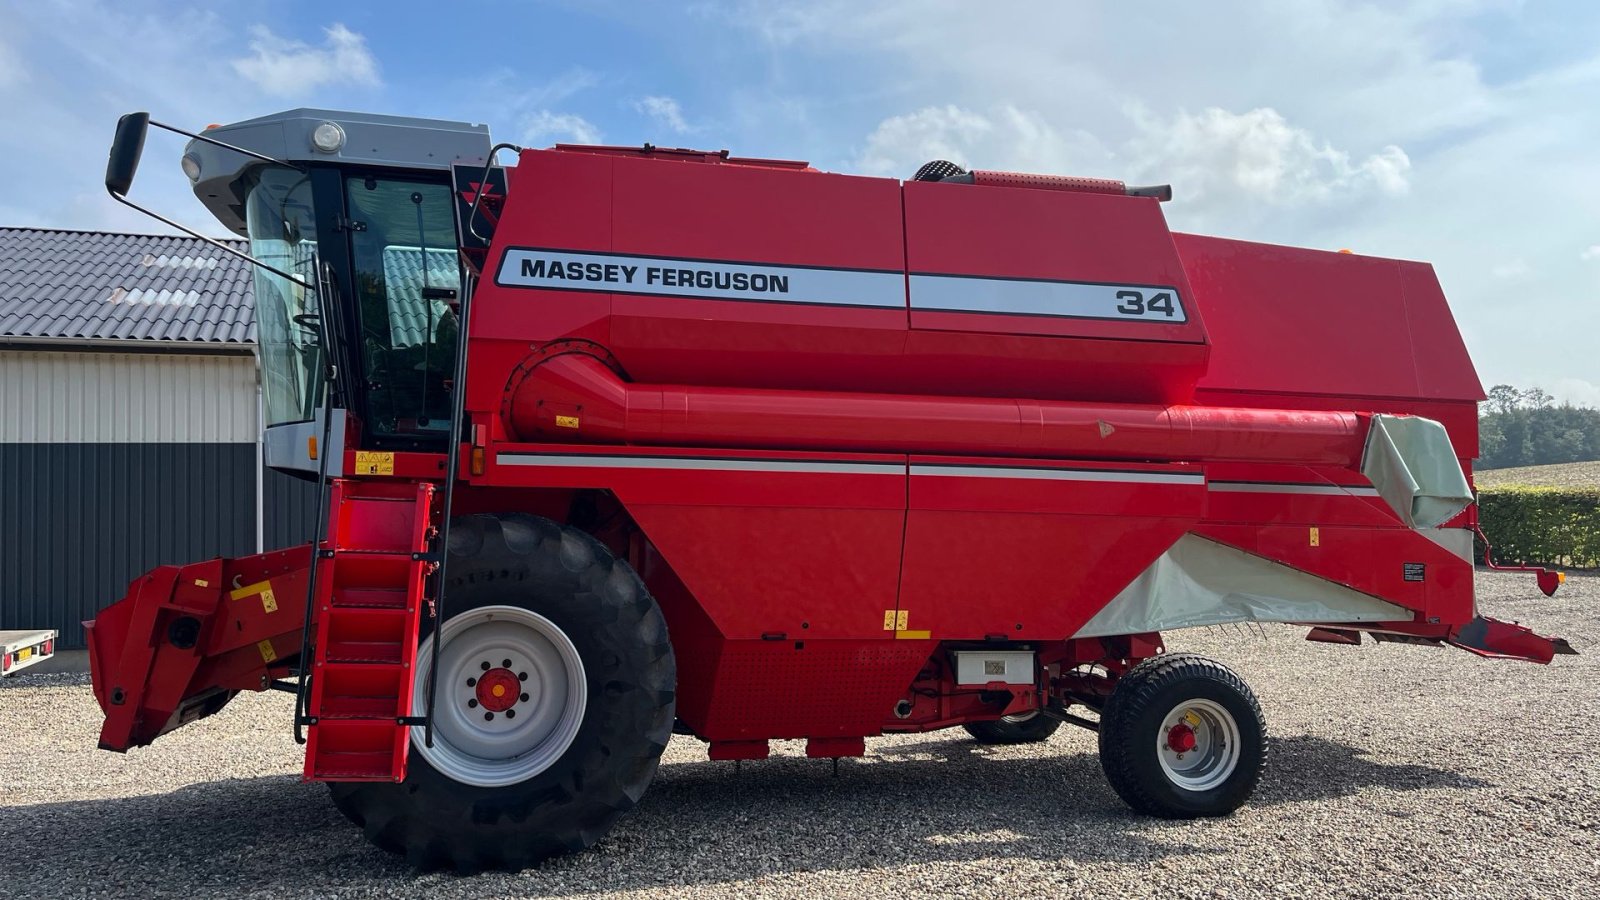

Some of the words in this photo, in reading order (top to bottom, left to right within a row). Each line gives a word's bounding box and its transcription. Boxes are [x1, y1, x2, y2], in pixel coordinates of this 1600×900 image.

[521, 259, 638, 284] MASSEY
[646, 267, 789, 293] FERGUSON
[1116, 290, 1175, 317] 34
